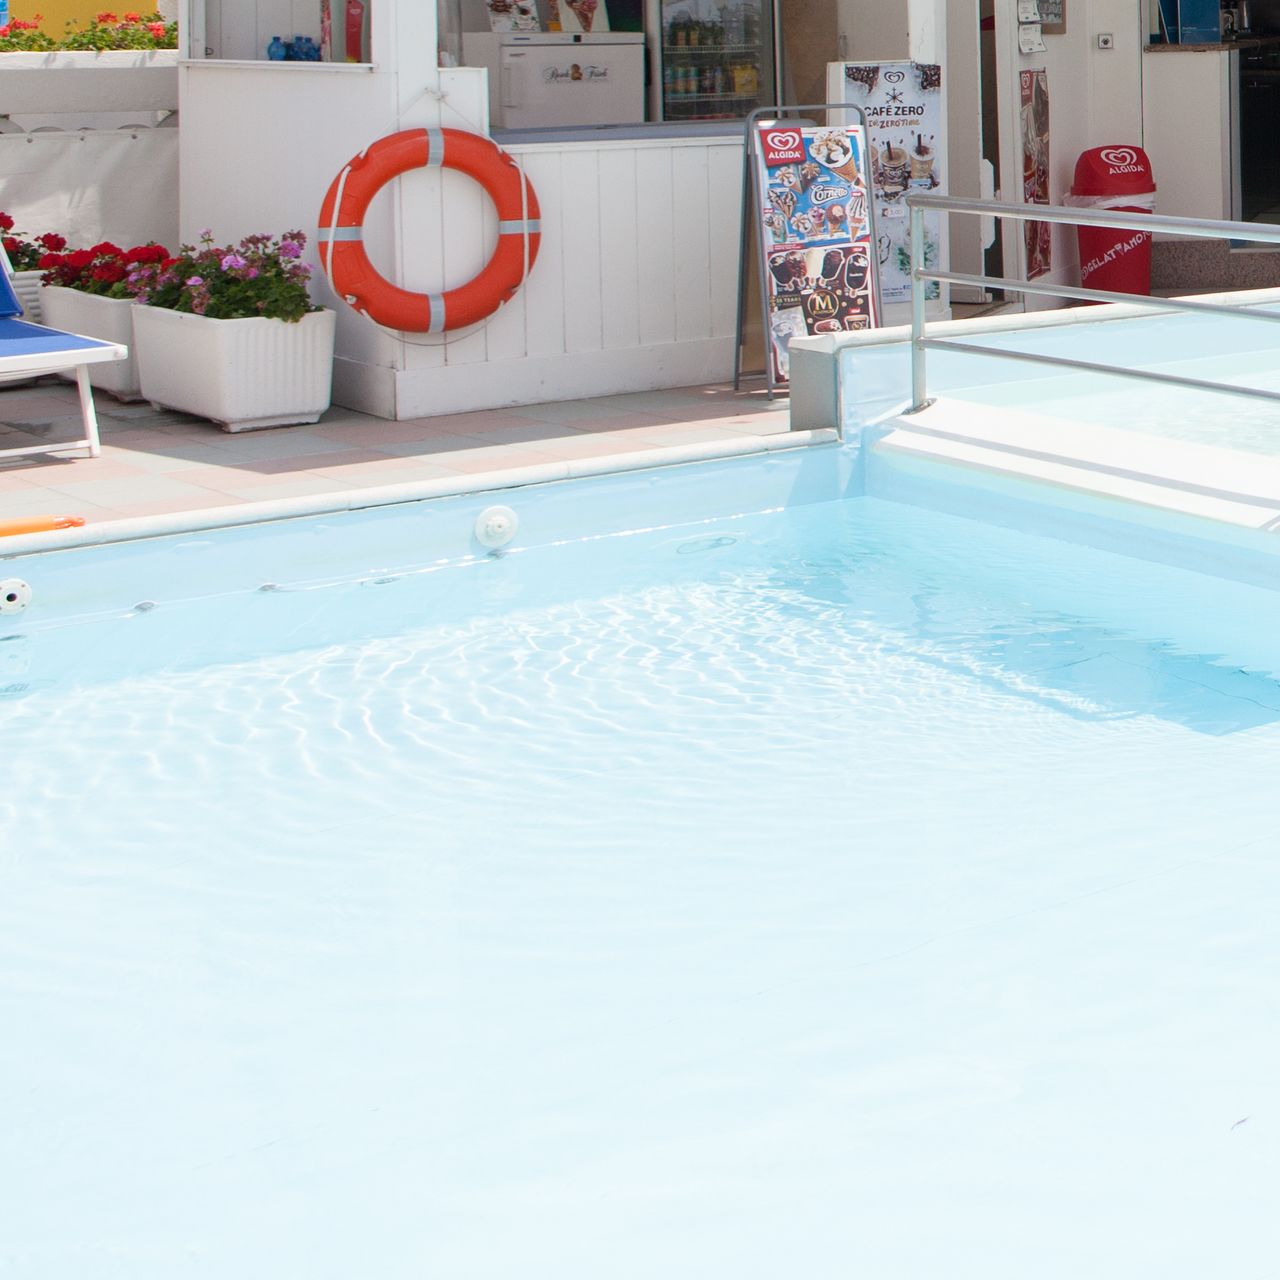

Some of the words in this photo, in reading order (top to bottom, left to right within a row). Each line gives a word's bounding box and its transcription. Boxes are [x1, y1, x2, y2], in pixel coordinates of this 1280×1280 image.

[894, 106, 924, 116] ZERO
[768, 150, 801, 159] ALGIDA
[1109, 165, 1144, 175] ALGIDA
[815, 295, 833, 310] M
